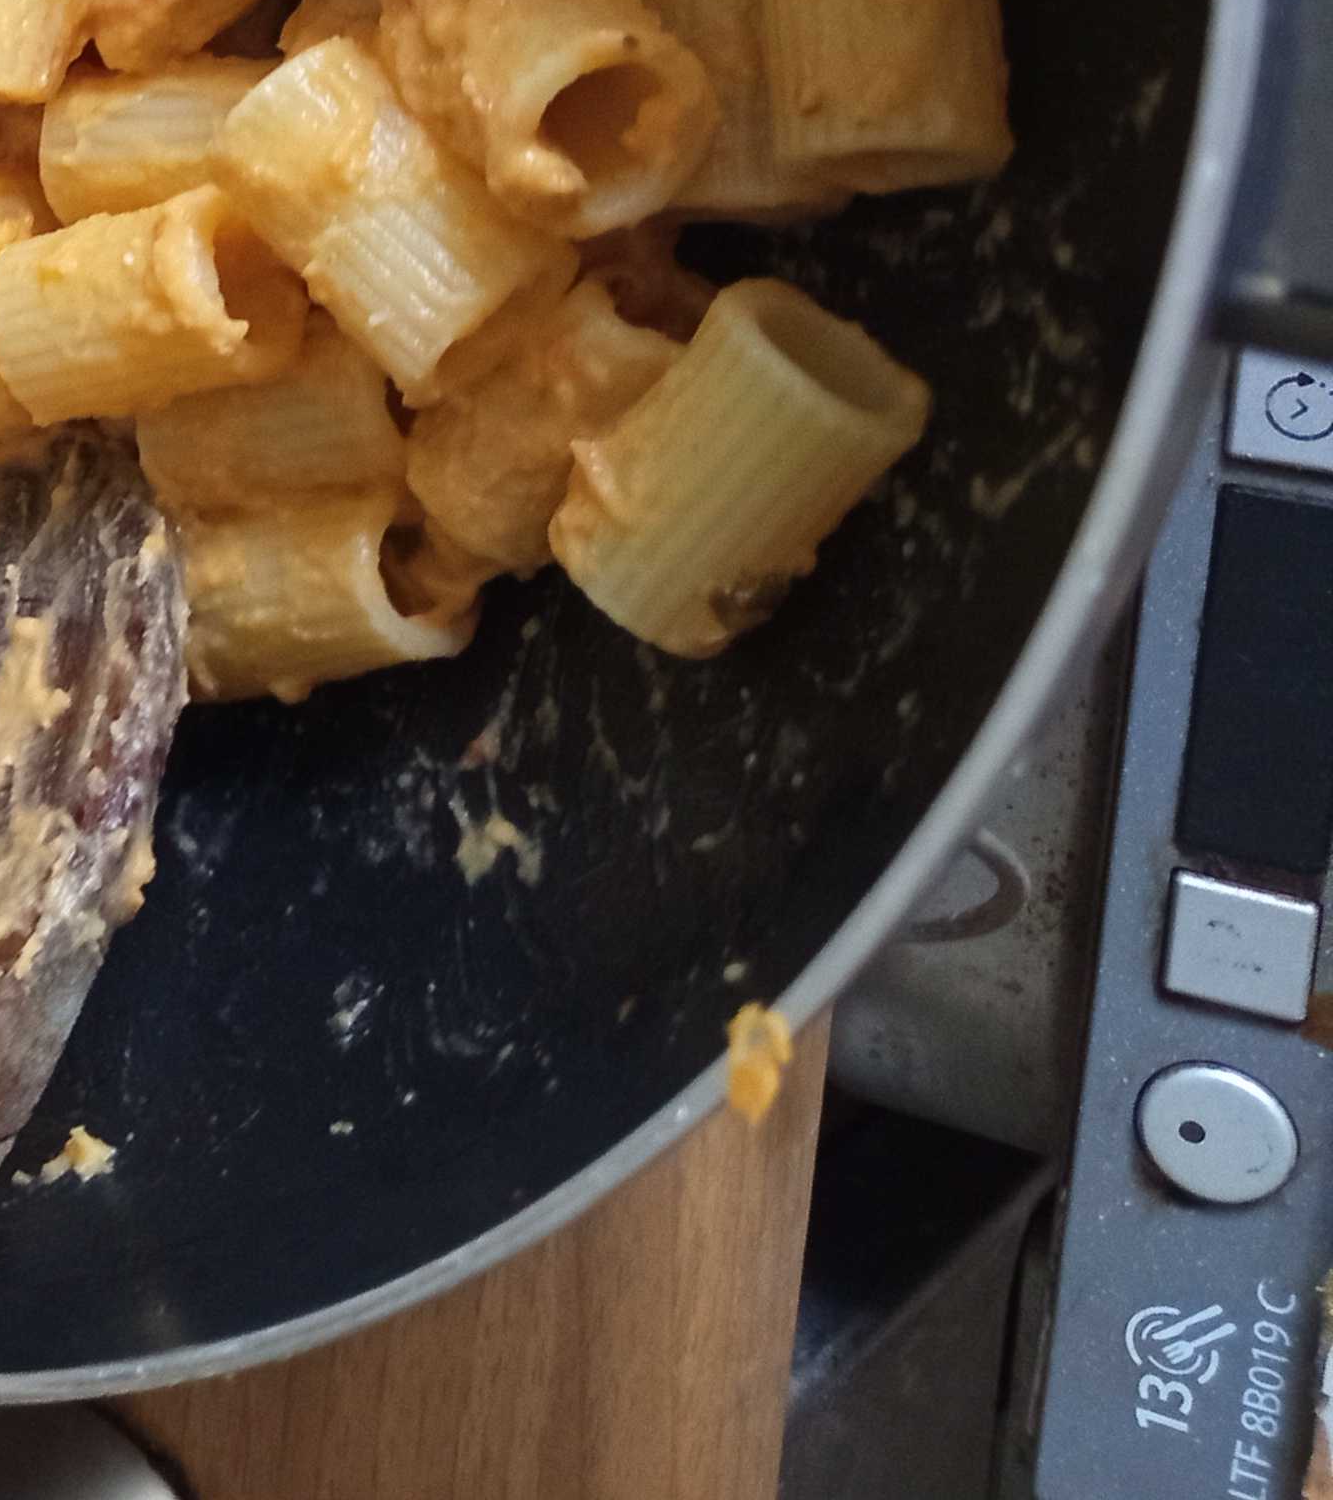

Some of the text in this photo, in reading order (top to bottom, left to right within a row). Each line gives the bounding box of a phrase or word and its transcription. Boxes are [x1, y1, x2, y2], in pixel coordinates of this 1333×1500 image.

[1135, 1373, 1193, 1433] 13
[1227, 1279, 1296, 1500] LTF 8B019 C
